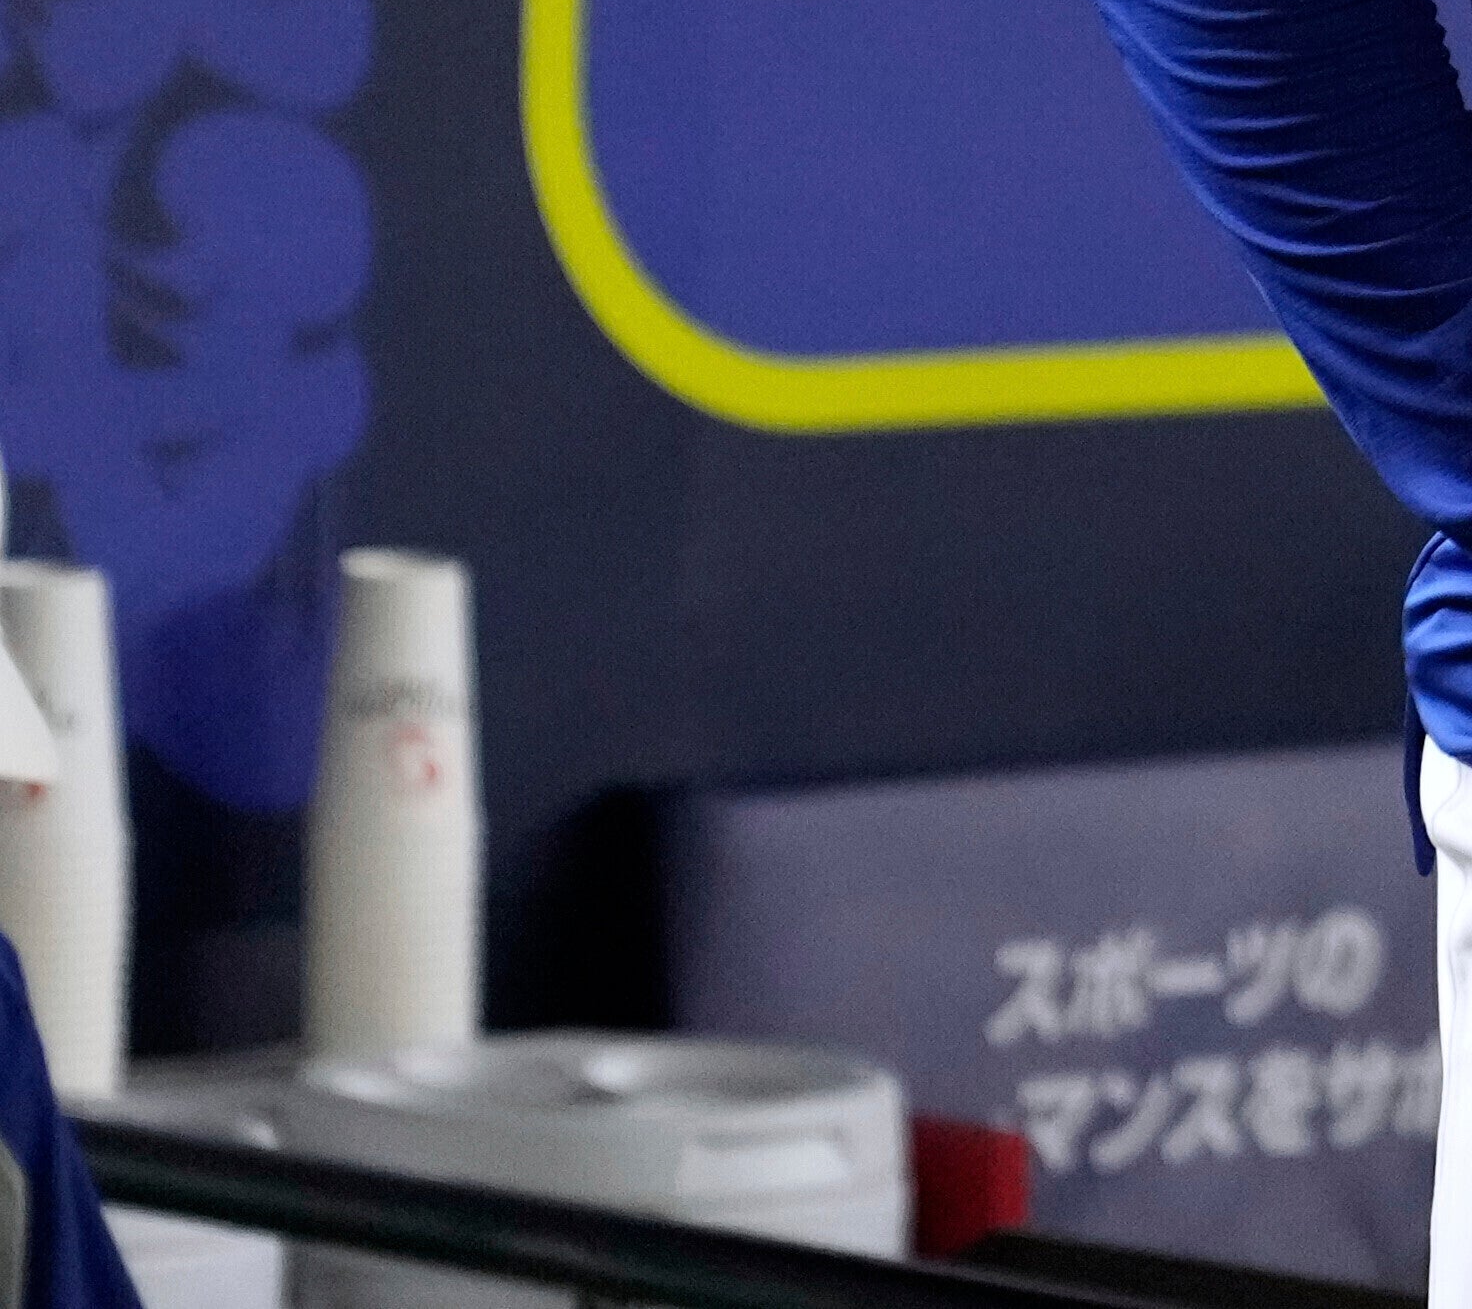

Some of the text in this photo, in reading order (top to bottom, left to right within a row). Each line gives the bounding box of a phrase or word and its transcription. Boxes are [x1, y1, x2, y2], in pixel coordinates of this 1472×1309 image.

[986, 908, 1384, 1047] スポーツの
